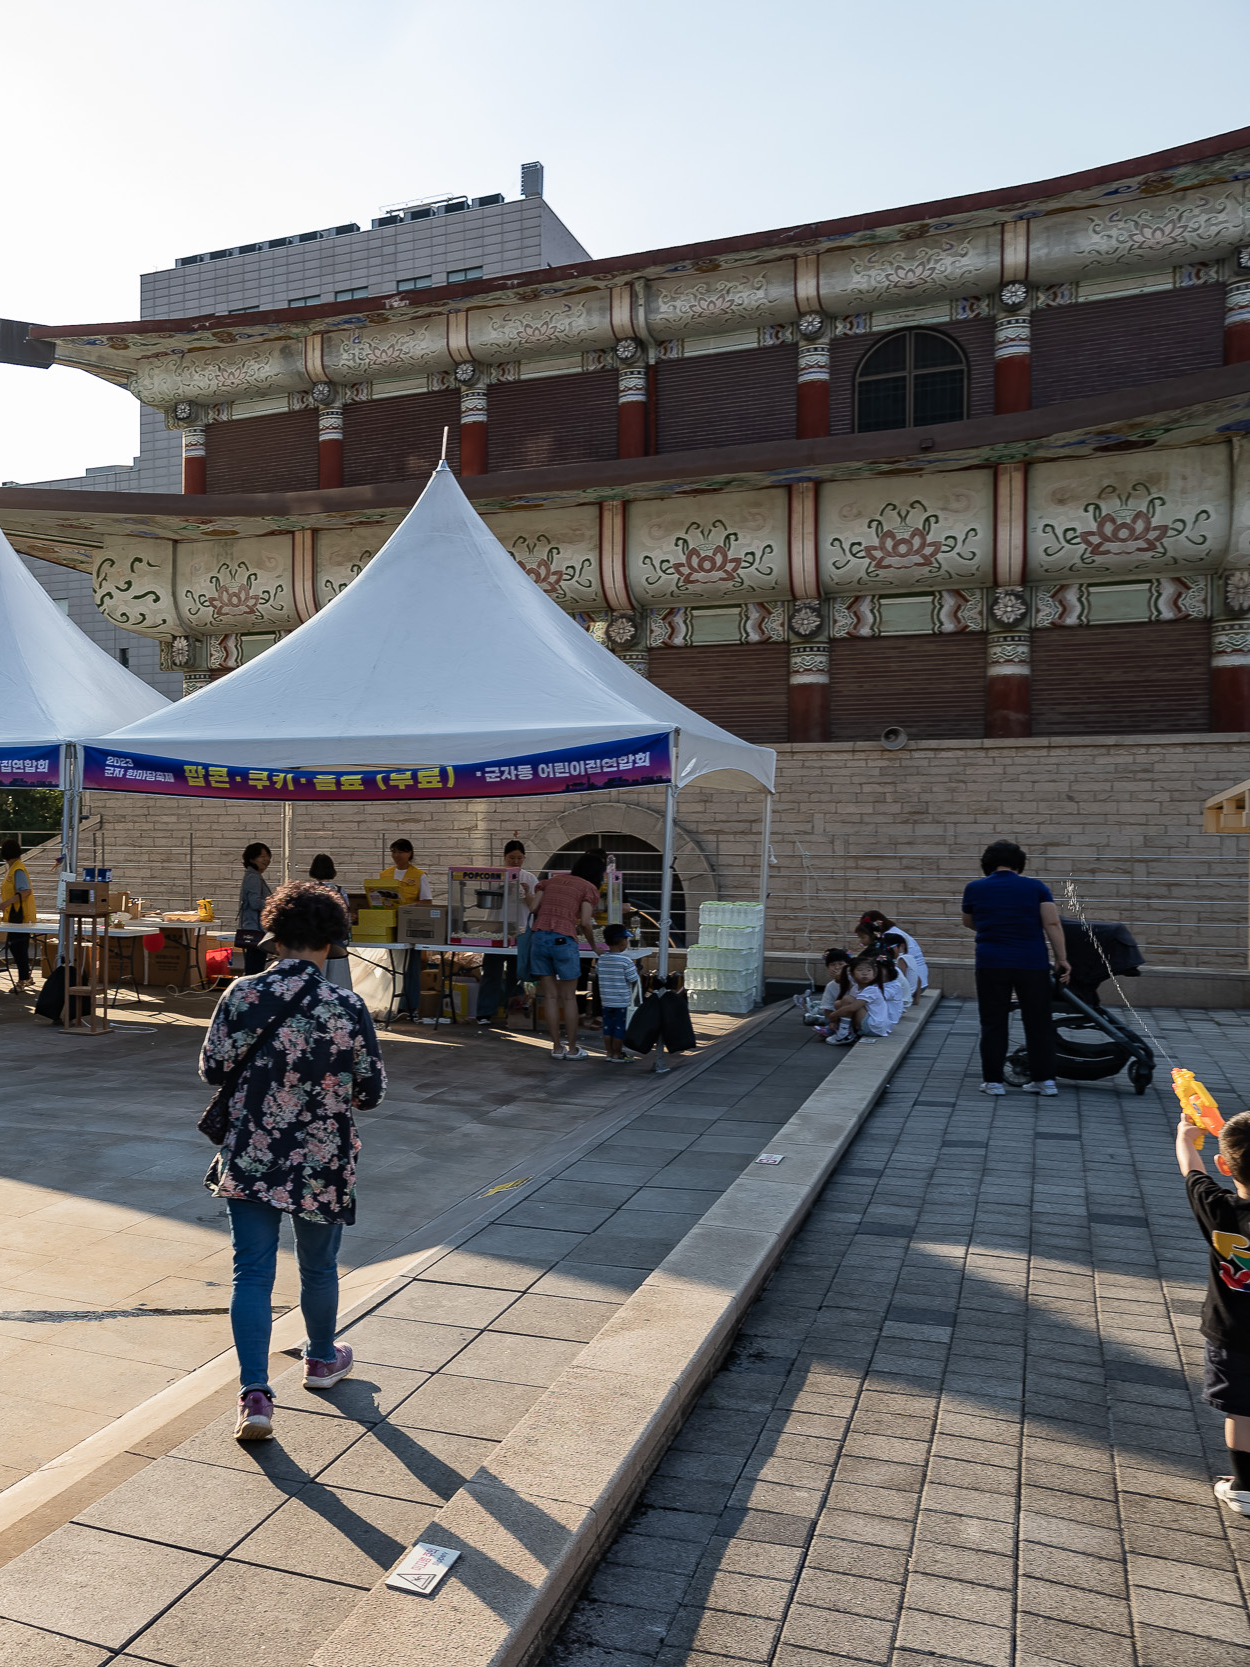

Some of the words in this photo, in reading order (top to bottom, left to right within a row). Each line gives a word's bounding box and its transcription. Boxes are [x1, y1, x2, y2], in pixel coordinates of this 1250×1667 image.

[105, 756, 134, 767] 2023
[104, 766, 125, 778] 군자
[126, 768, 175, 783] 한마당축제
[377, 765, 455, 790] (무료)
[538, 751, 651, 779] 어린이집연합회
[462, 871, 502, 881] POPCORN
